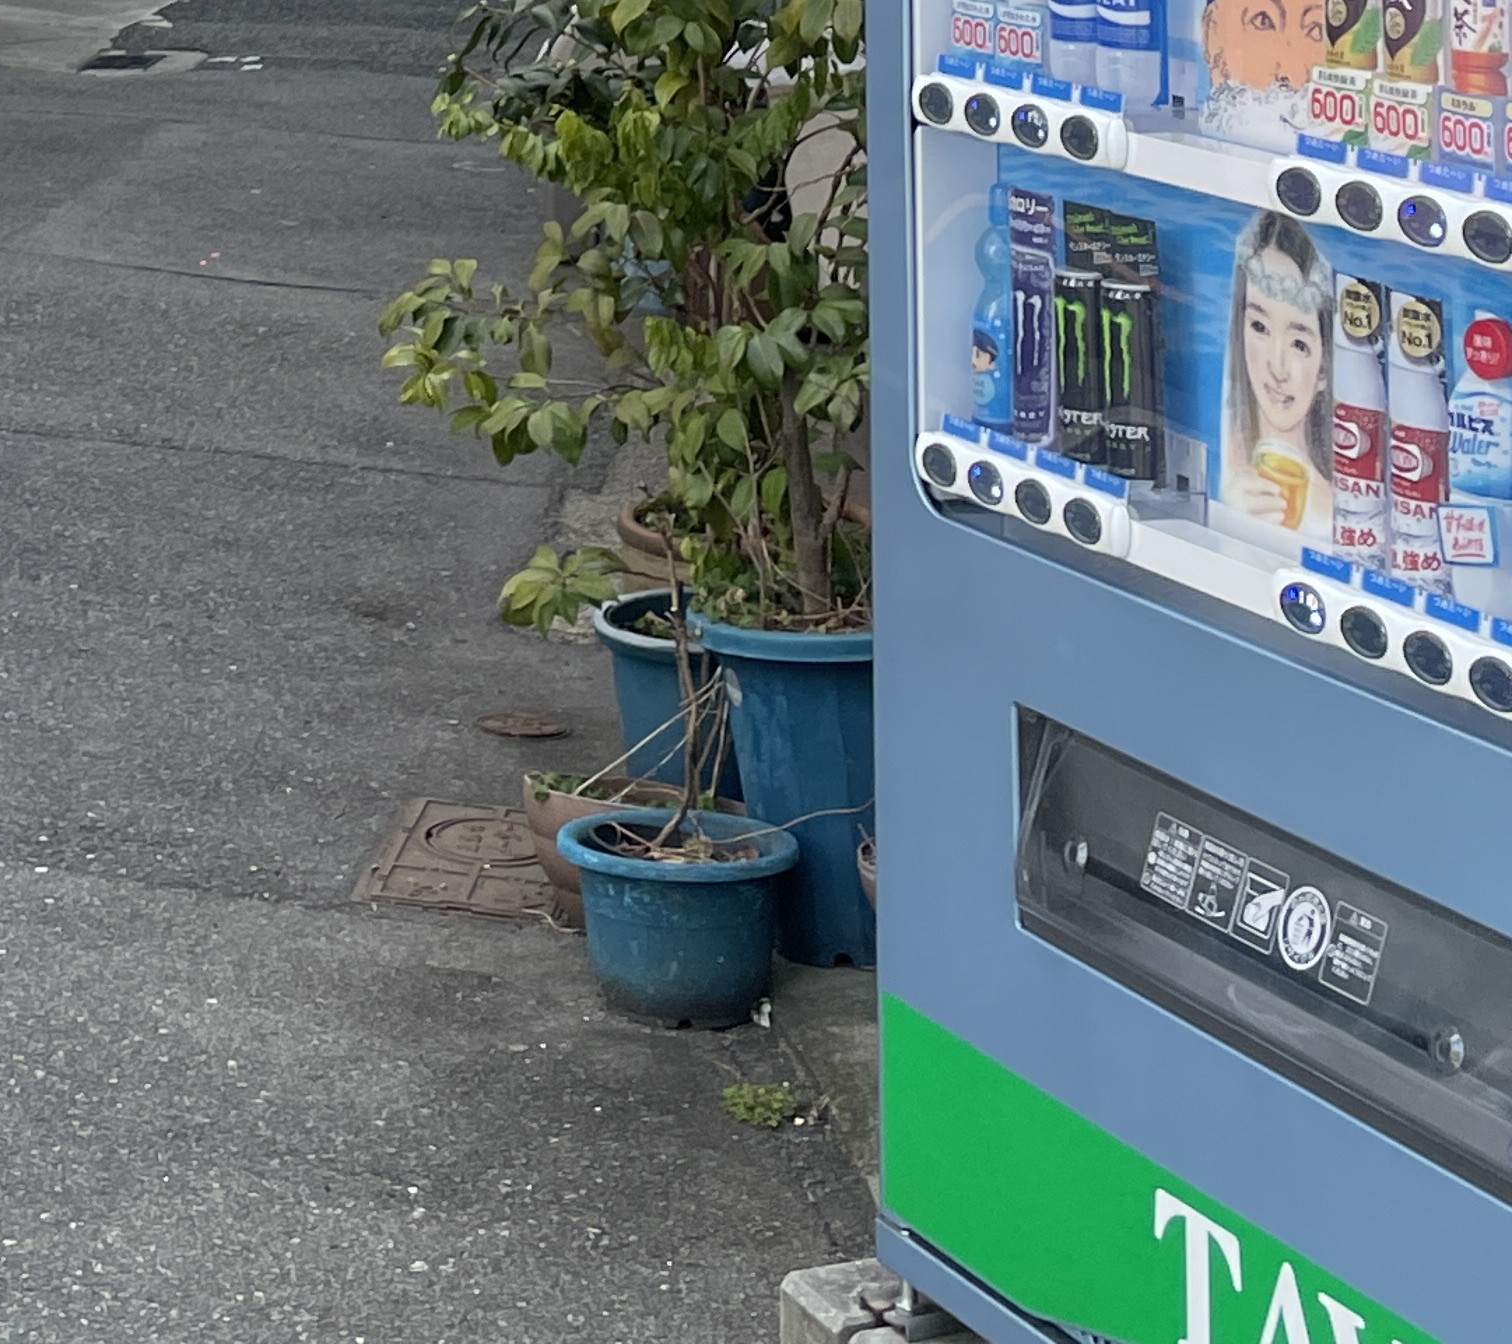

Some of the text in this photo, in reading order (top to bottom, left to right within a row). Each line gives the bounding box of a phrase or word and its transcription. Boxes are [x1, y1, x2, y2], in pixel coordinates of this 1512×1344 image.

[953, 15, 987, 50] 600
[997, 25, 1034, 59] 600
[1311, 87, 1356, 126] 600
[1373, 100, 1419, 141] 600
[1441, 114, 1484, 155] 600
[1344, 310, 1373, 330] No.1
[1400, 330, 1434, 350] No.1
[1335, 476, 1381, 499] SAN
